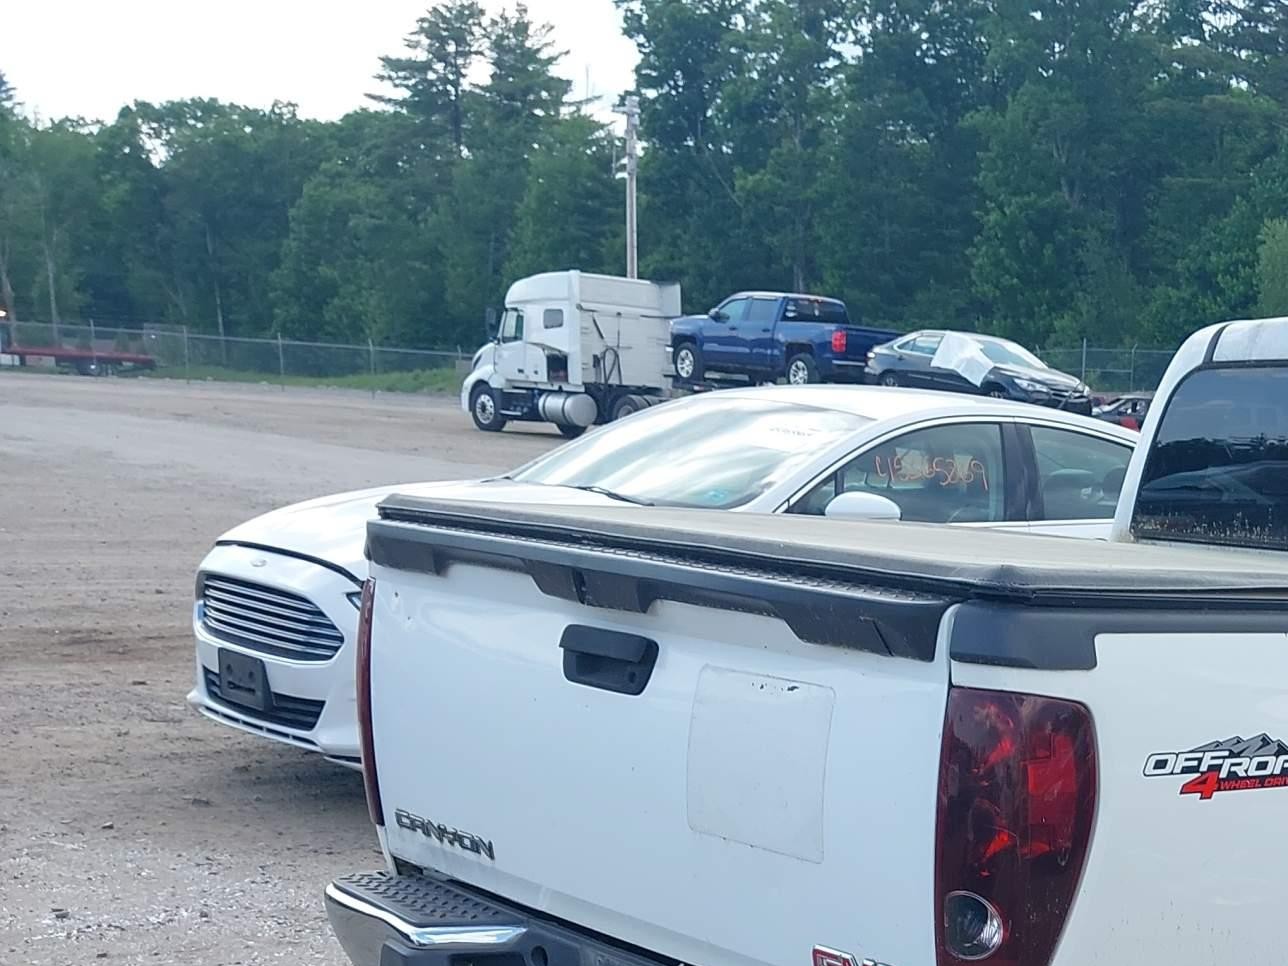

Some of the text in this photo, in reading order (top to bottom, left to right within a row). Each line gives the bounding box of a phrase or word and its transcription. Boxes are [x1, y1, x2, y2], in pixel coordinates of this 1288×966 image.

[1180, 771, 1219, 799] 4
[1219, 779, 1262, 790] WHEEL
[395, 808, 495, 861] CANYON
